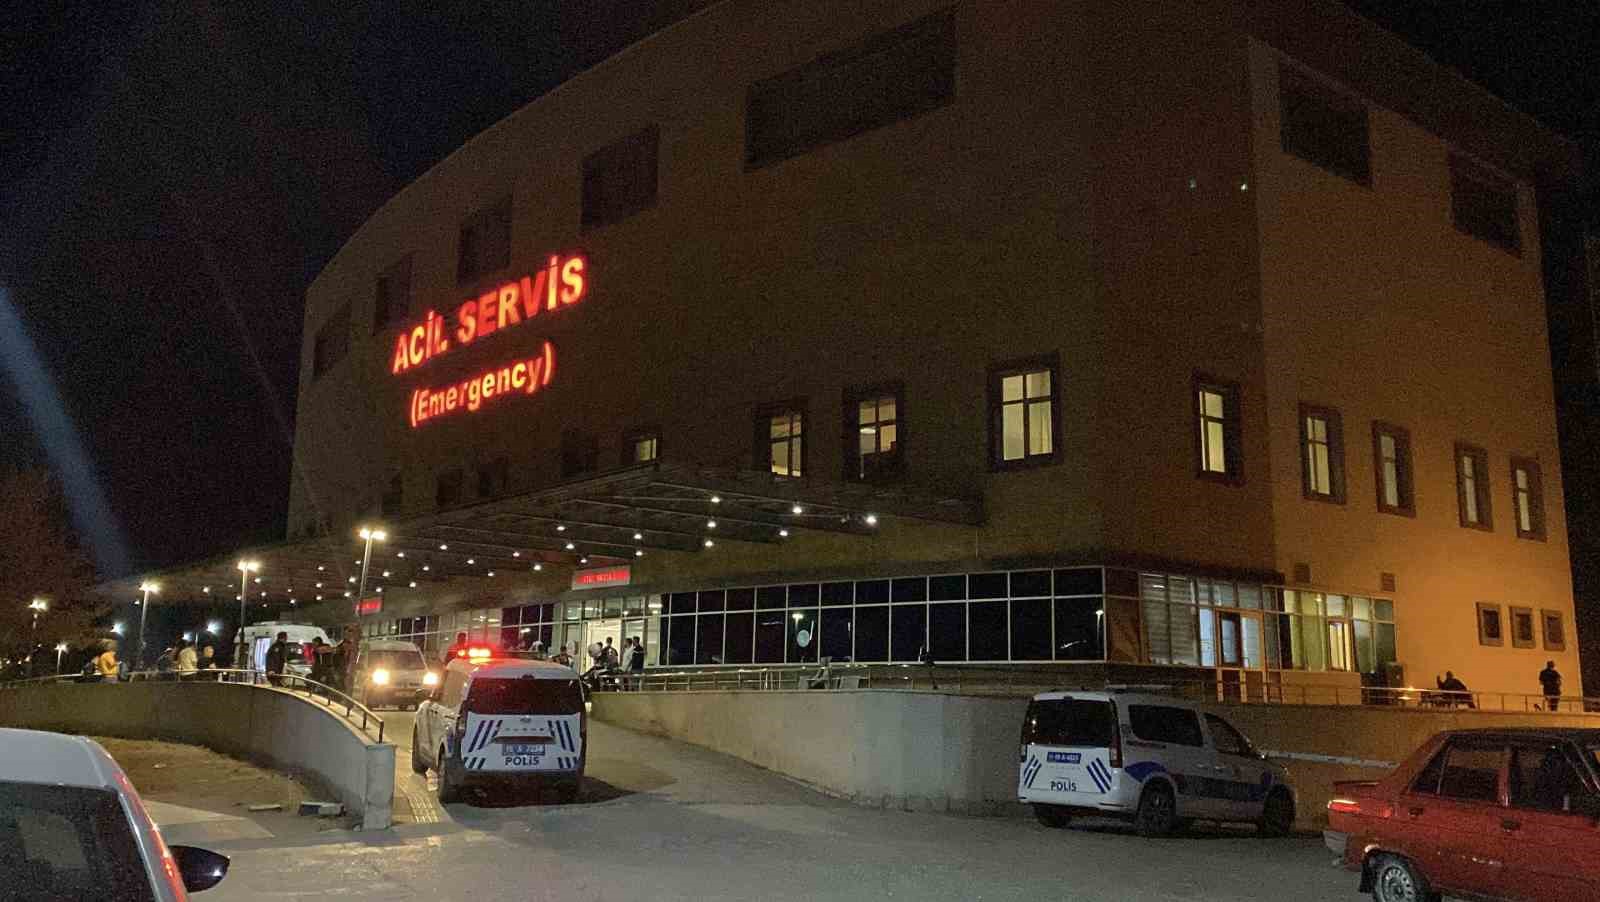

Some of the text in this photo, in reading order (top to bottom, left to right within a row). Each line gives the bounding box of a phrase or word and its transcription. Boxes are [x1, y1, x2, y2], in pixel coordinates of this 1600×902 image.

[392, 255, 585, 374] ACİL SERVİS
[410, 341, 553, 427] (Emergency)
